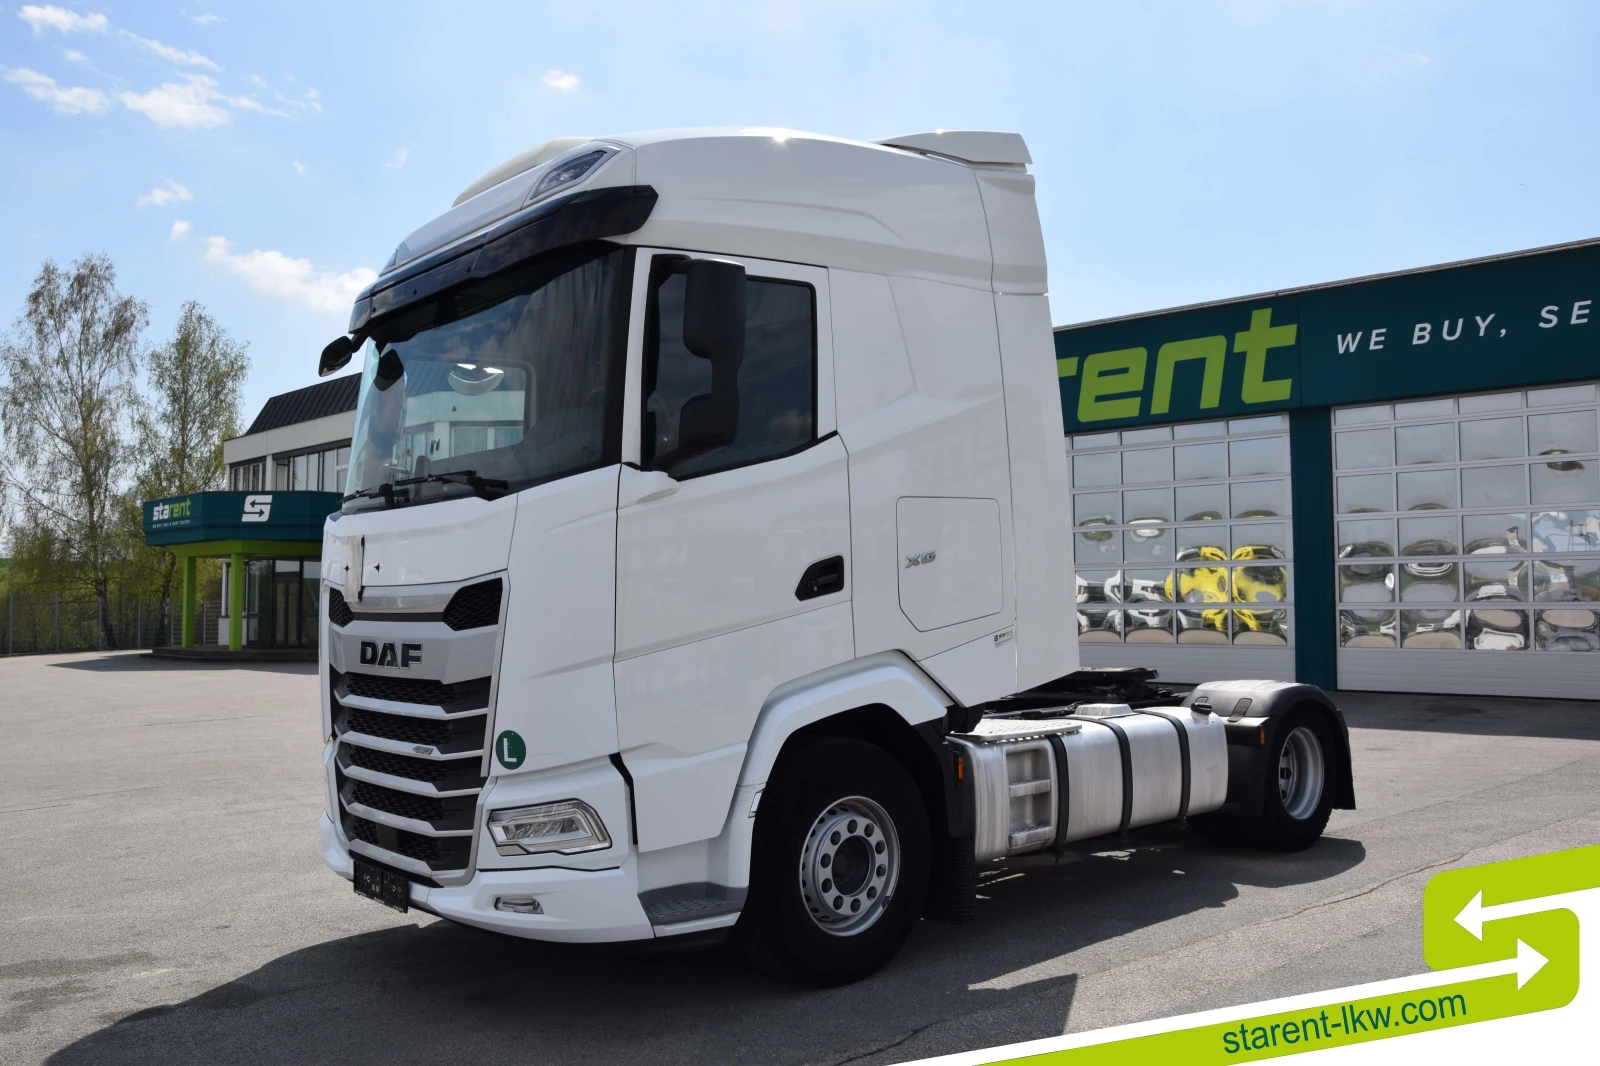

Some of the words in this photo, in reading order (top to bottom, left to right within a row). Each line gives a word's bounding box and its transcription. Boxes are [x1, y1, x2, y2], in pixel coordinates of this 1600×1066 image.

[1336, 327, 1388, 355] WE
[1411, 313, 1507, 345] BUY,
[1538, 299, 1593, 329] SE
[152, 498, 191, 521] starent
[360, 640, 423, 669] DAF
[503, 737, 517, 763] L
